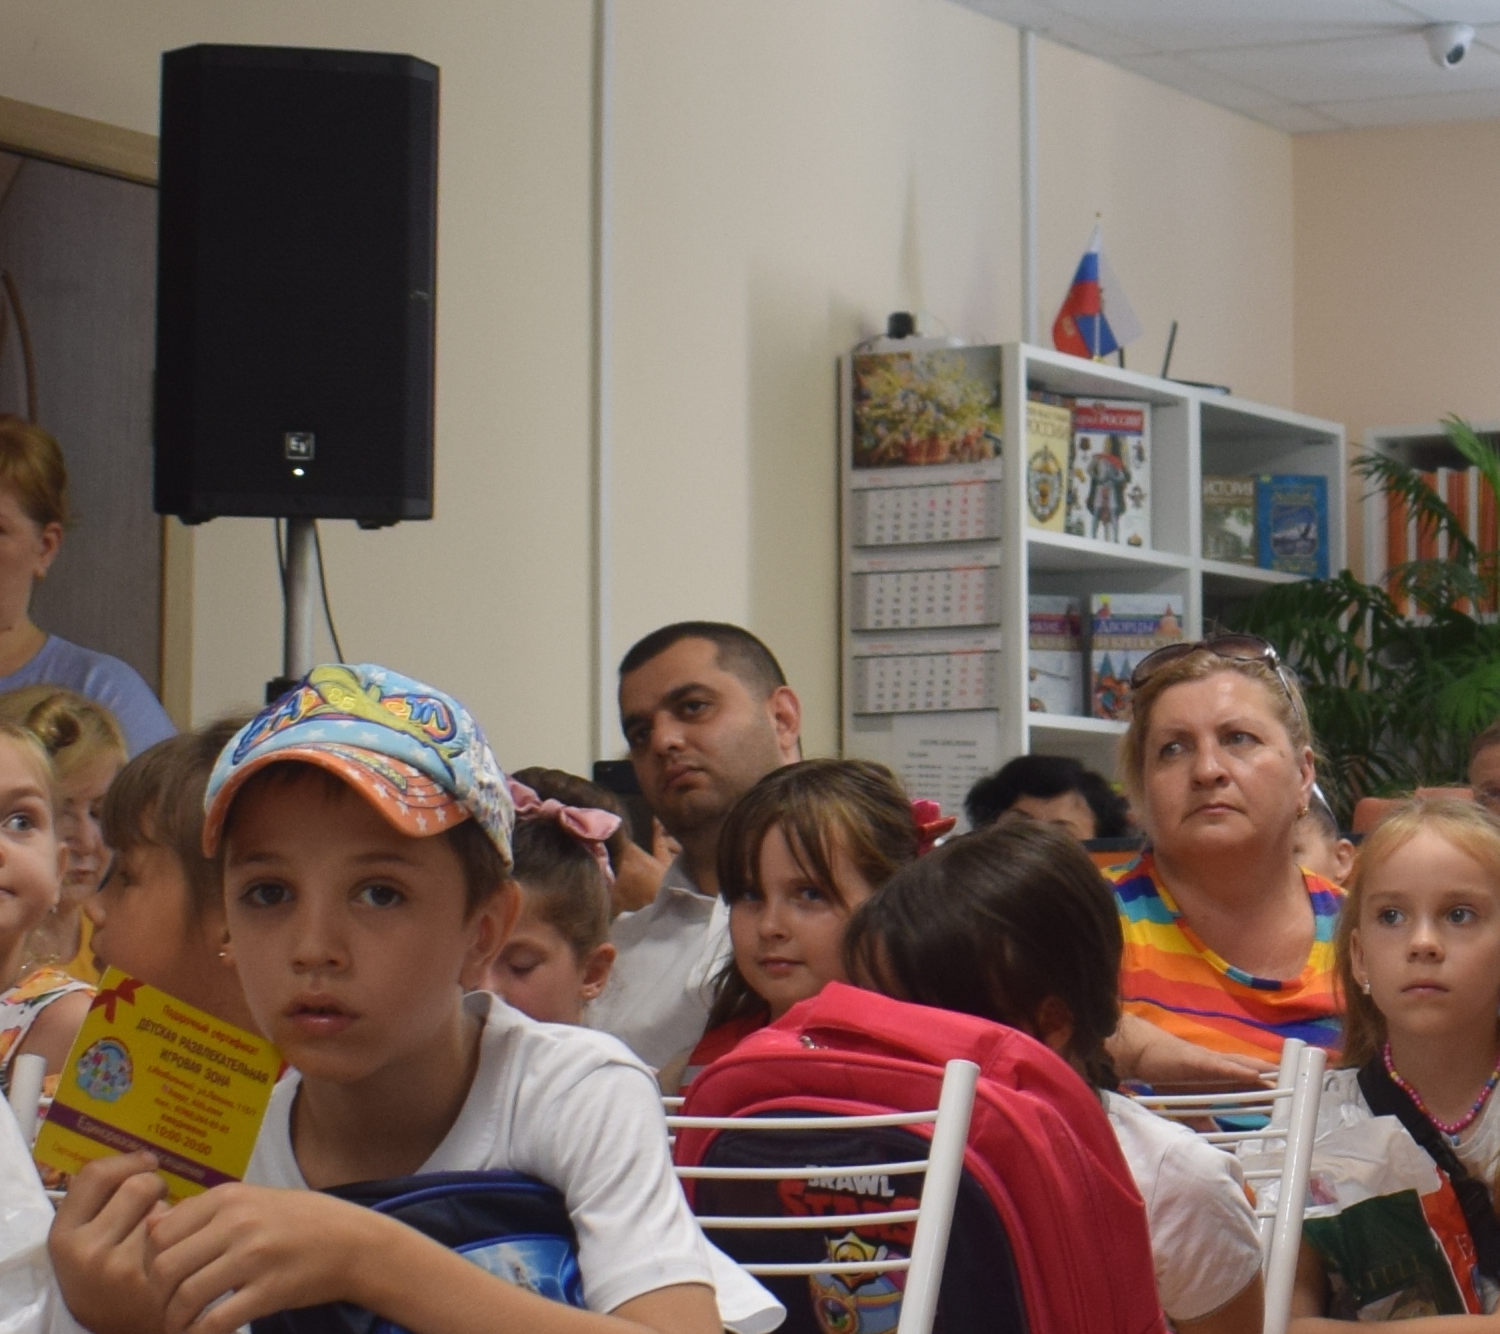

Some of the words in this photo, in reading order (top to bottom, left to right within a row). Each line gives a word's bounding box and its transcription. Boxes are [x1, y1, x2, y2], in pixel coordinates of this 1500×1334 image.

[136, 1017, 177, 1043] ДЕТСКАЯ
[179, 1035, 270, 1085] РАЗВЛЕКАТЕЛЬНАЯ
[159, 1049, 202, 1074] ИГРОВАЯ
[204, 1068, 231, 1088] ЗОНА
[806, 1164, 895, 1198] BRAWL
